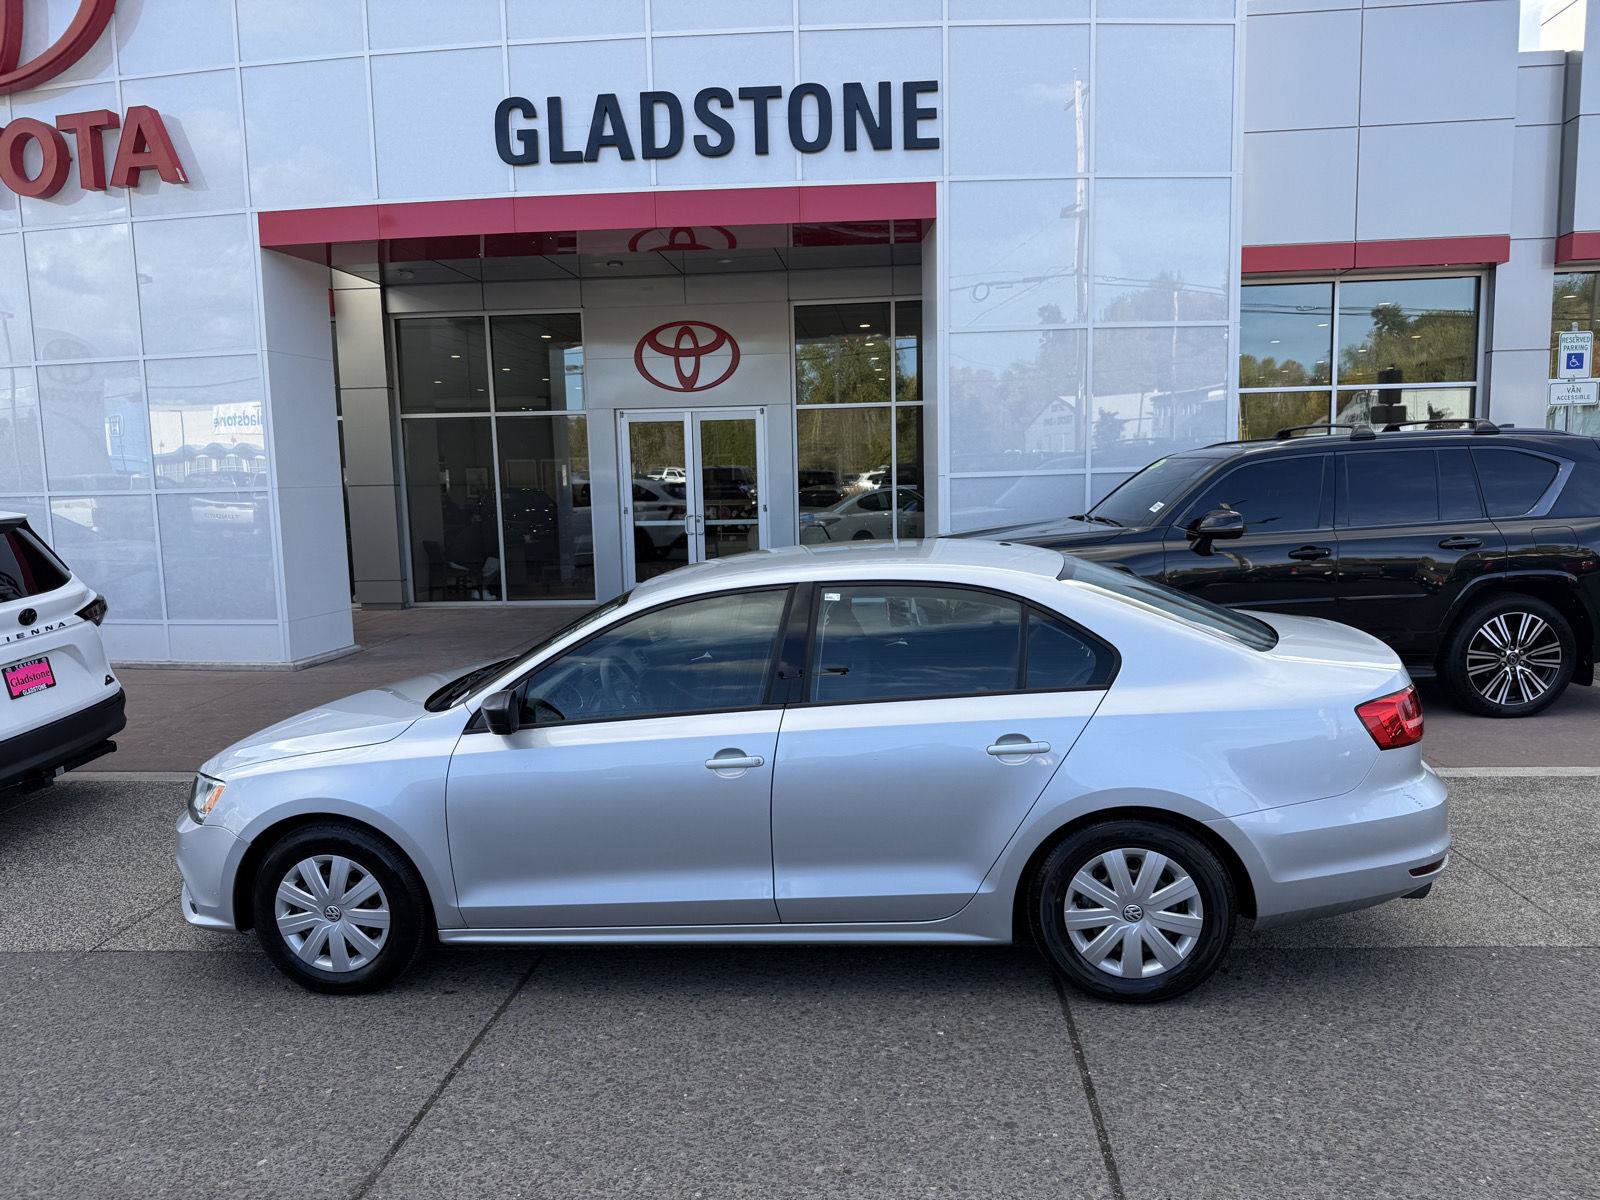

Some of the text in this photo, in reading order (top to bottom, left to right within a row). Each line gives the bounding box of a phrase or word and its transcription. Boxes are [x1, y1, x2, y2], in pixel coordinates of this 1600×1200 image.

[494, 80, 941, 167] GLADSTONE
[0, 105, 190, 200] OTA
[1561, 336, 1591, 344] RESERVED
[1562, 344, 1589, 352] PARKING
[1566, 386, 1582, 394] VAN
[6, 621, 66, 642] IENNA
[9, 670, 51, 688] Gladstone
